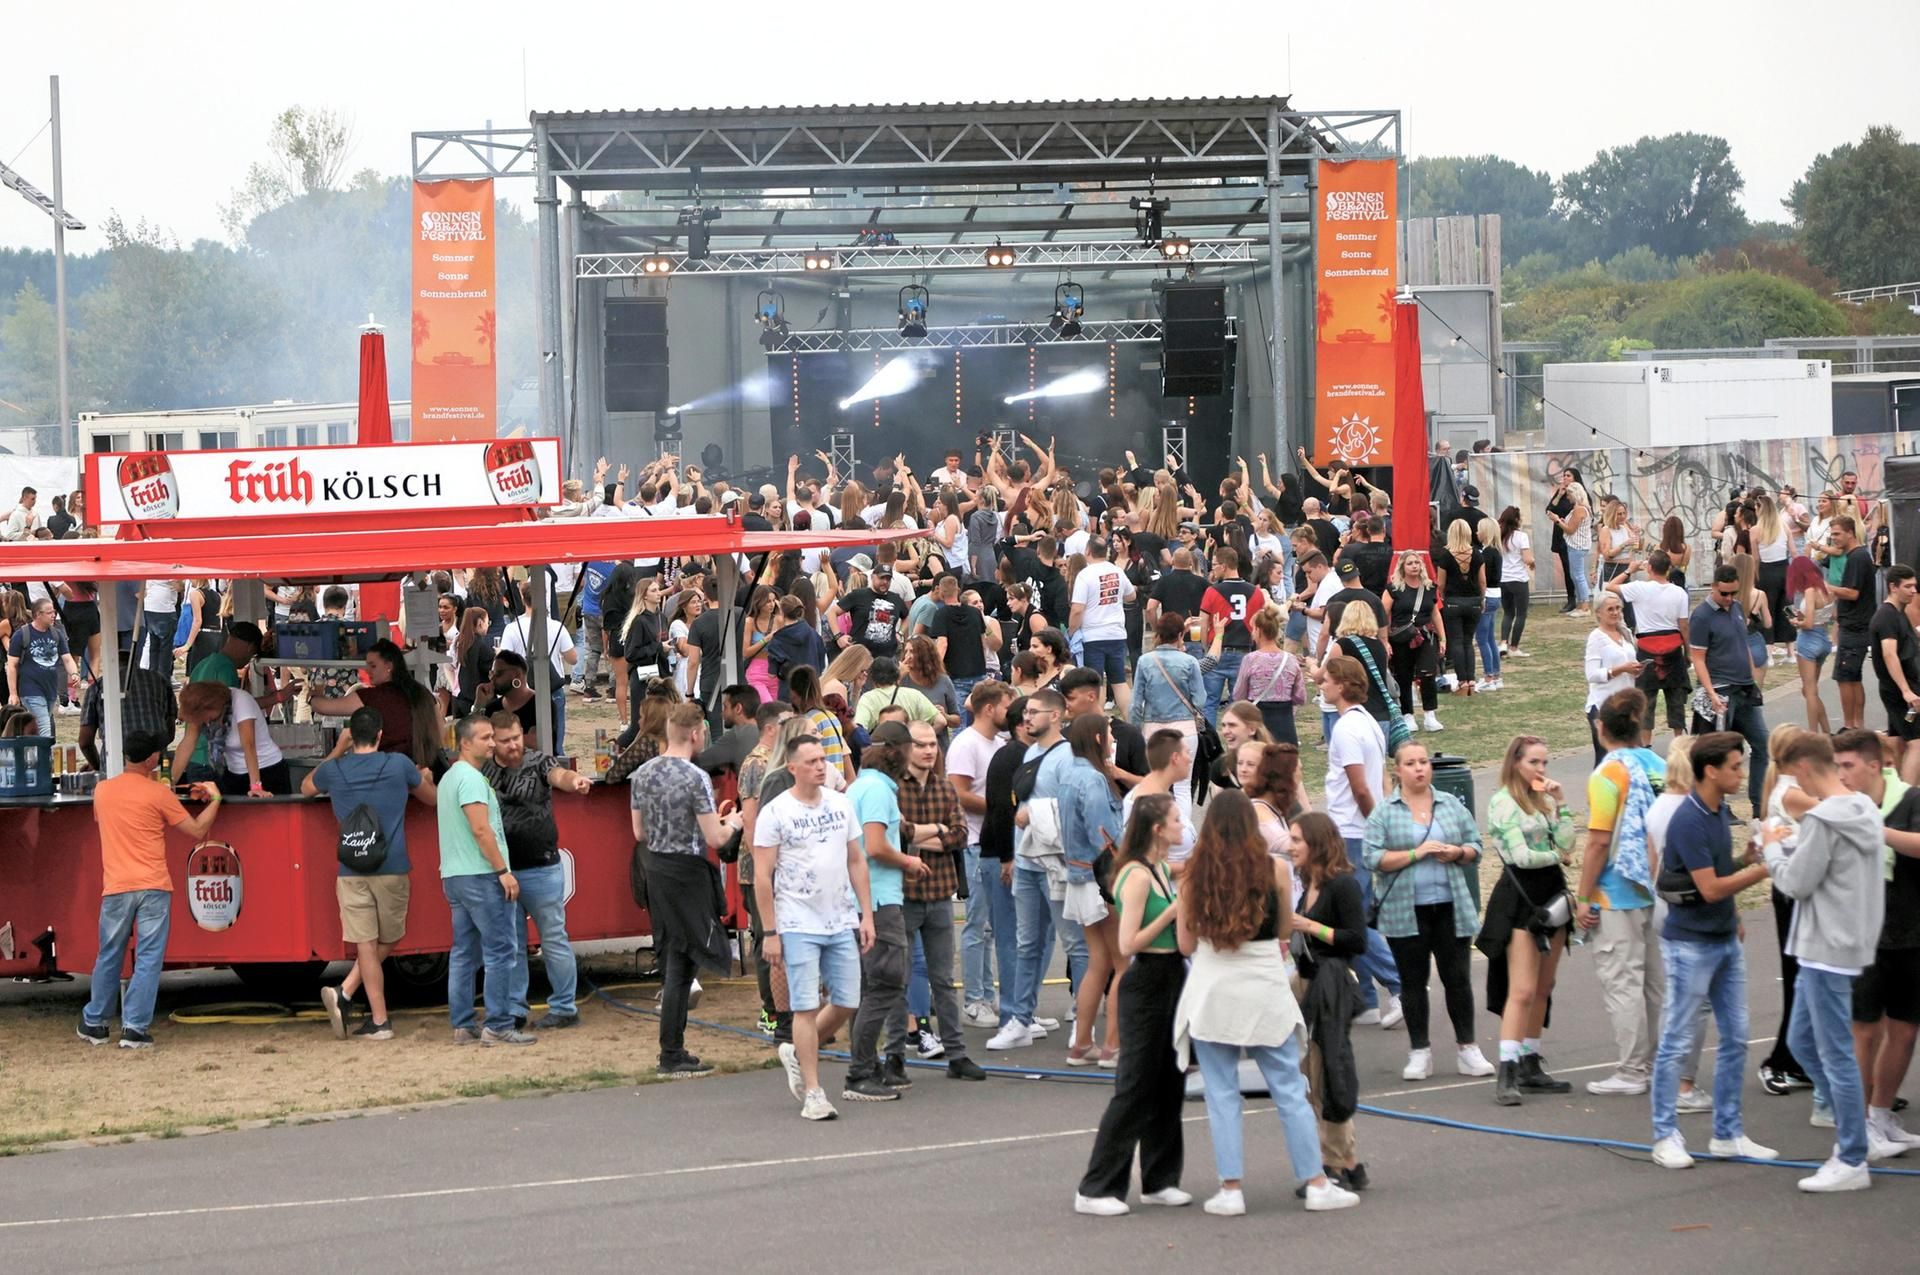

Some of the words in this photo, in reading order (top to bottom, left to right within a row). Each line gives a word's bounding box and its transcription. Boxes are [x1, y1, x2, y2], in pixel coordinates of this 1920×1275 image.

[1337, 202, 1385, 212] BRAND
[1326, 211, 1390, 221] FESTIVAL
[433, 221, 483, 232] BRAND
[421, 230, 487, 241] FESTIVAL
[1335, 232, 1378, 241] Sommer
[432, 253, 475, 262] Sommer
[1341, 250, 1373, 259] Sonne
[438, 272, 469, 281] Sonne
[1324, 268, 1390, 277] Sonnenbrand
[420, 289, 488, 299] Sonnenbrand
[323, 471, 442, 501] KÖLSCH
[143, 502, 166, 513] KÖLSCH
[1230, 594, 1247, 620] 3
[342, 831, 376, 851] Laugh
